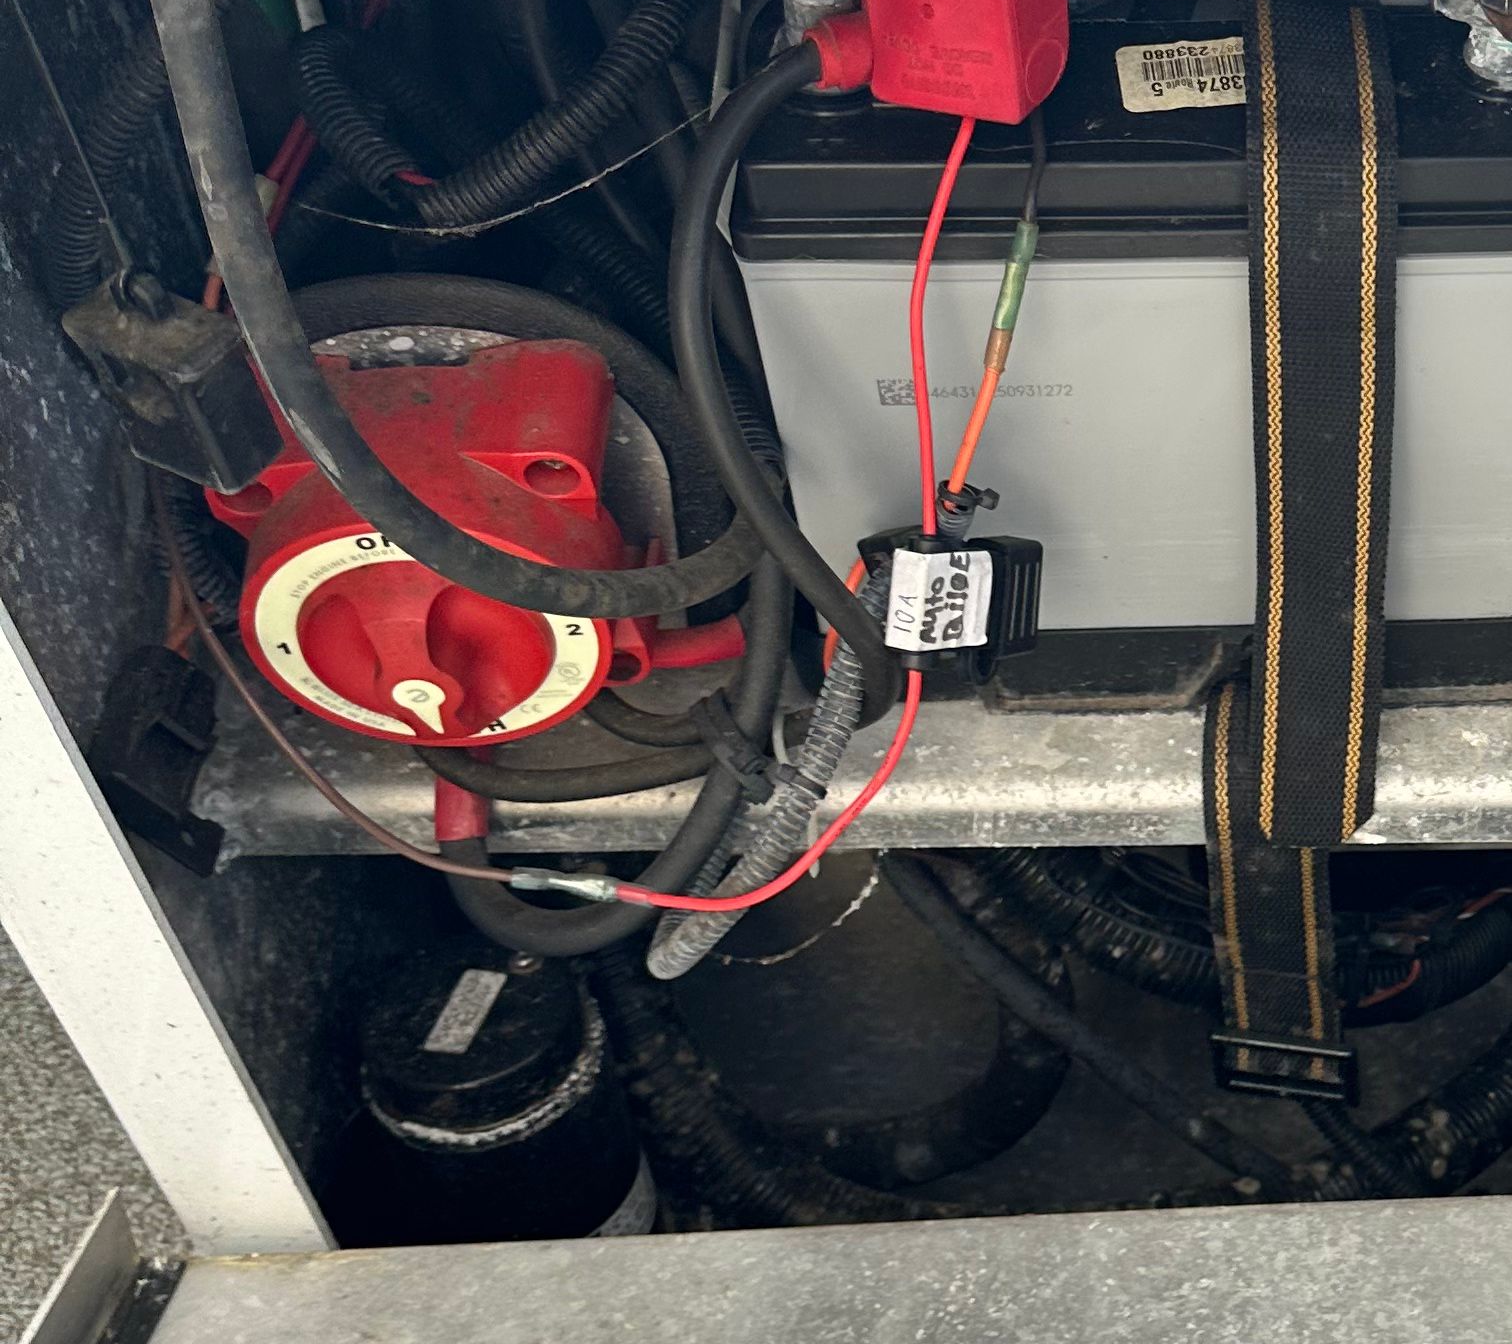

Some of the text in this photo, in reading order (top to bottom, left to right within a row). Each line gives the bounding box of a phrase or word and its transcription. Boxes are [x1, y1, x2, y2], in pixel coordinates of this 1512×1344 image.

[1150, 81, 1164, 97] 5
[1197, 75, 1244, 94] 3874
[566, 624, 583, 636] 2
[276, 642, 292, 655] 1
